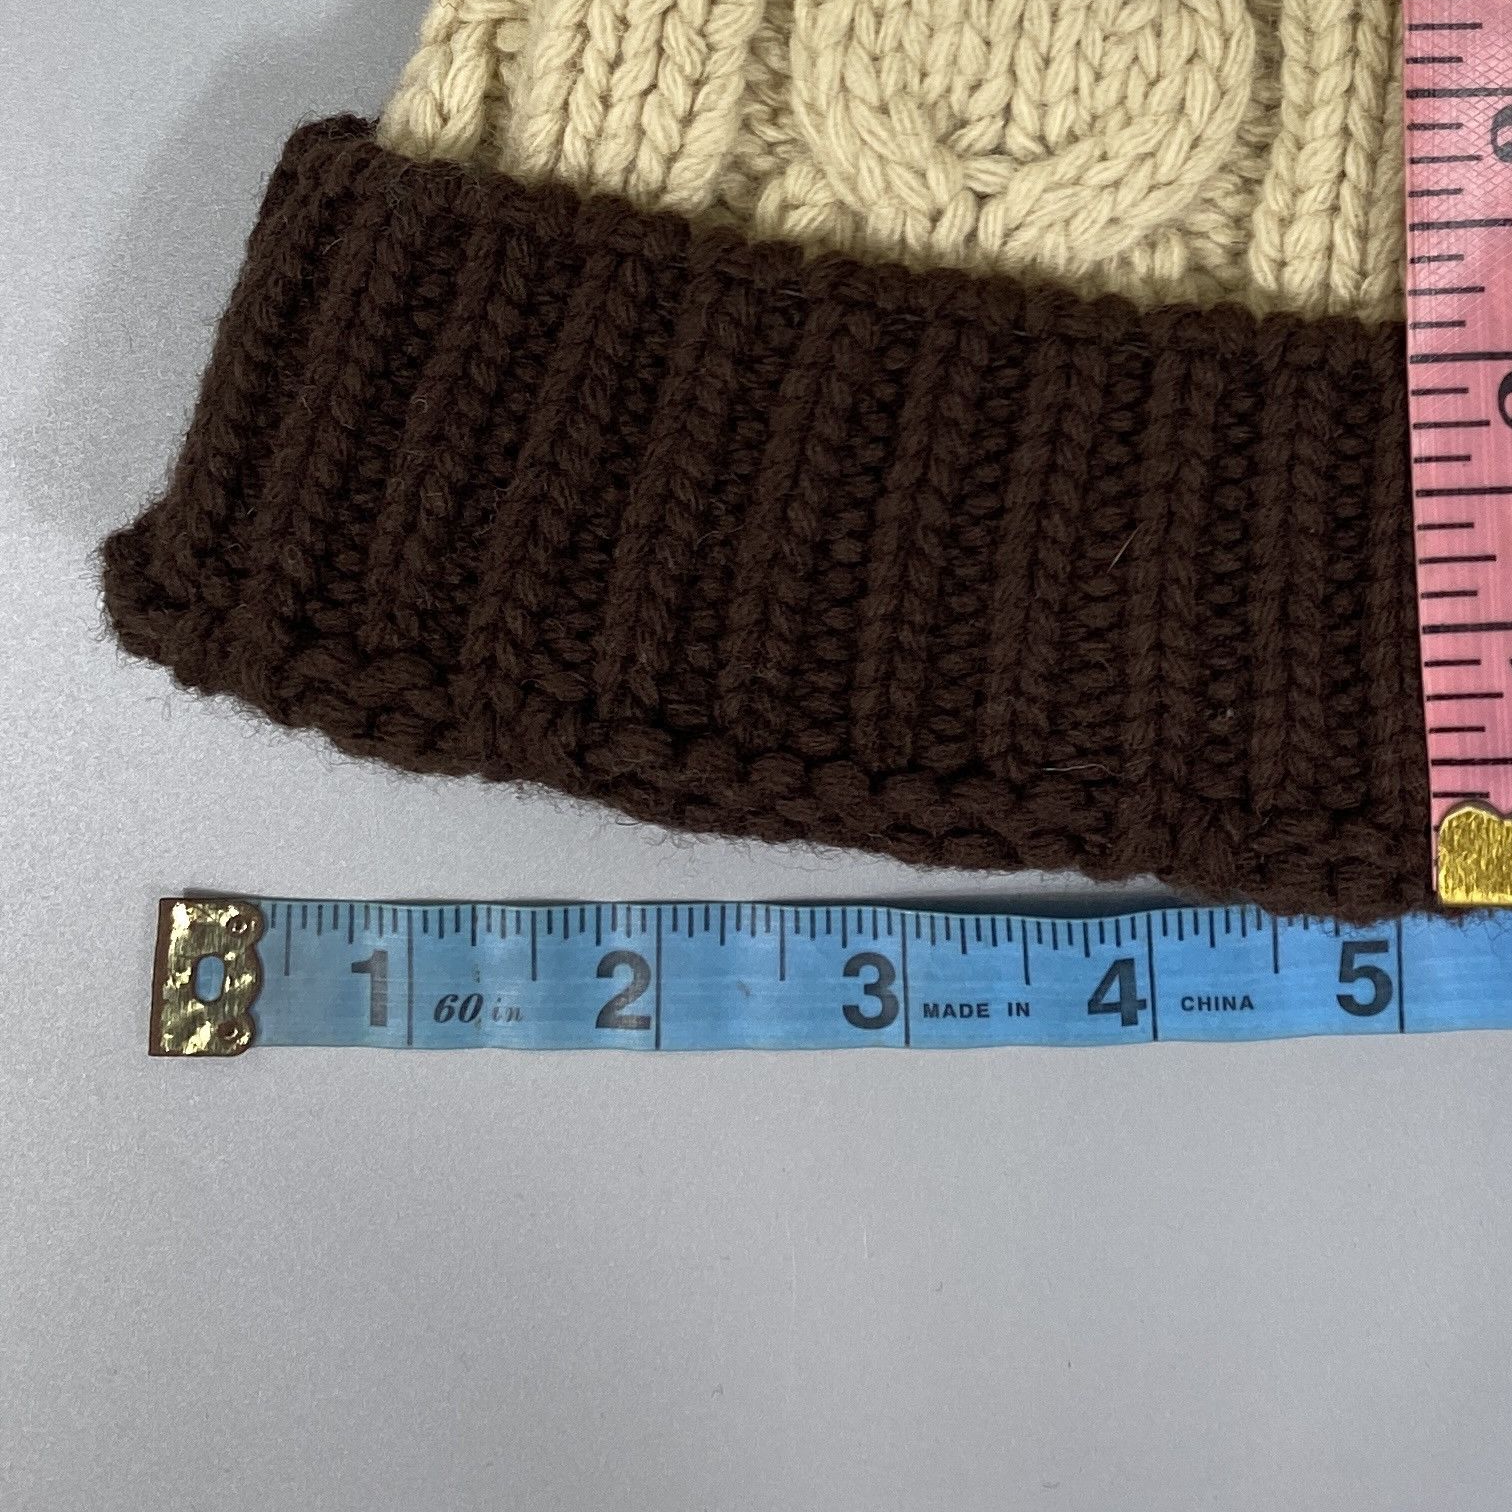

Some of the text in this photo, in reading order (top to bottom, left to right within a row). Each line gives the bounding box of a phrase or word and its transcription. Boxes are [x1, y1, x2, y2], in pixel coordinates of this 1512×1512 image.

[351, 949, 389, 1028] 1
[432, 993, 524, 1024] 60 in
[595, 950, 653, 1031] 2
[841, 952, 899, 1030] 3
[923, 1000, 1031, 1019] MADE IN
[1087, 958, 1147, 1027] 4
[1180, 994, 1255, 1013] CHINA
[1335, 940, 1393, 1017] 5
